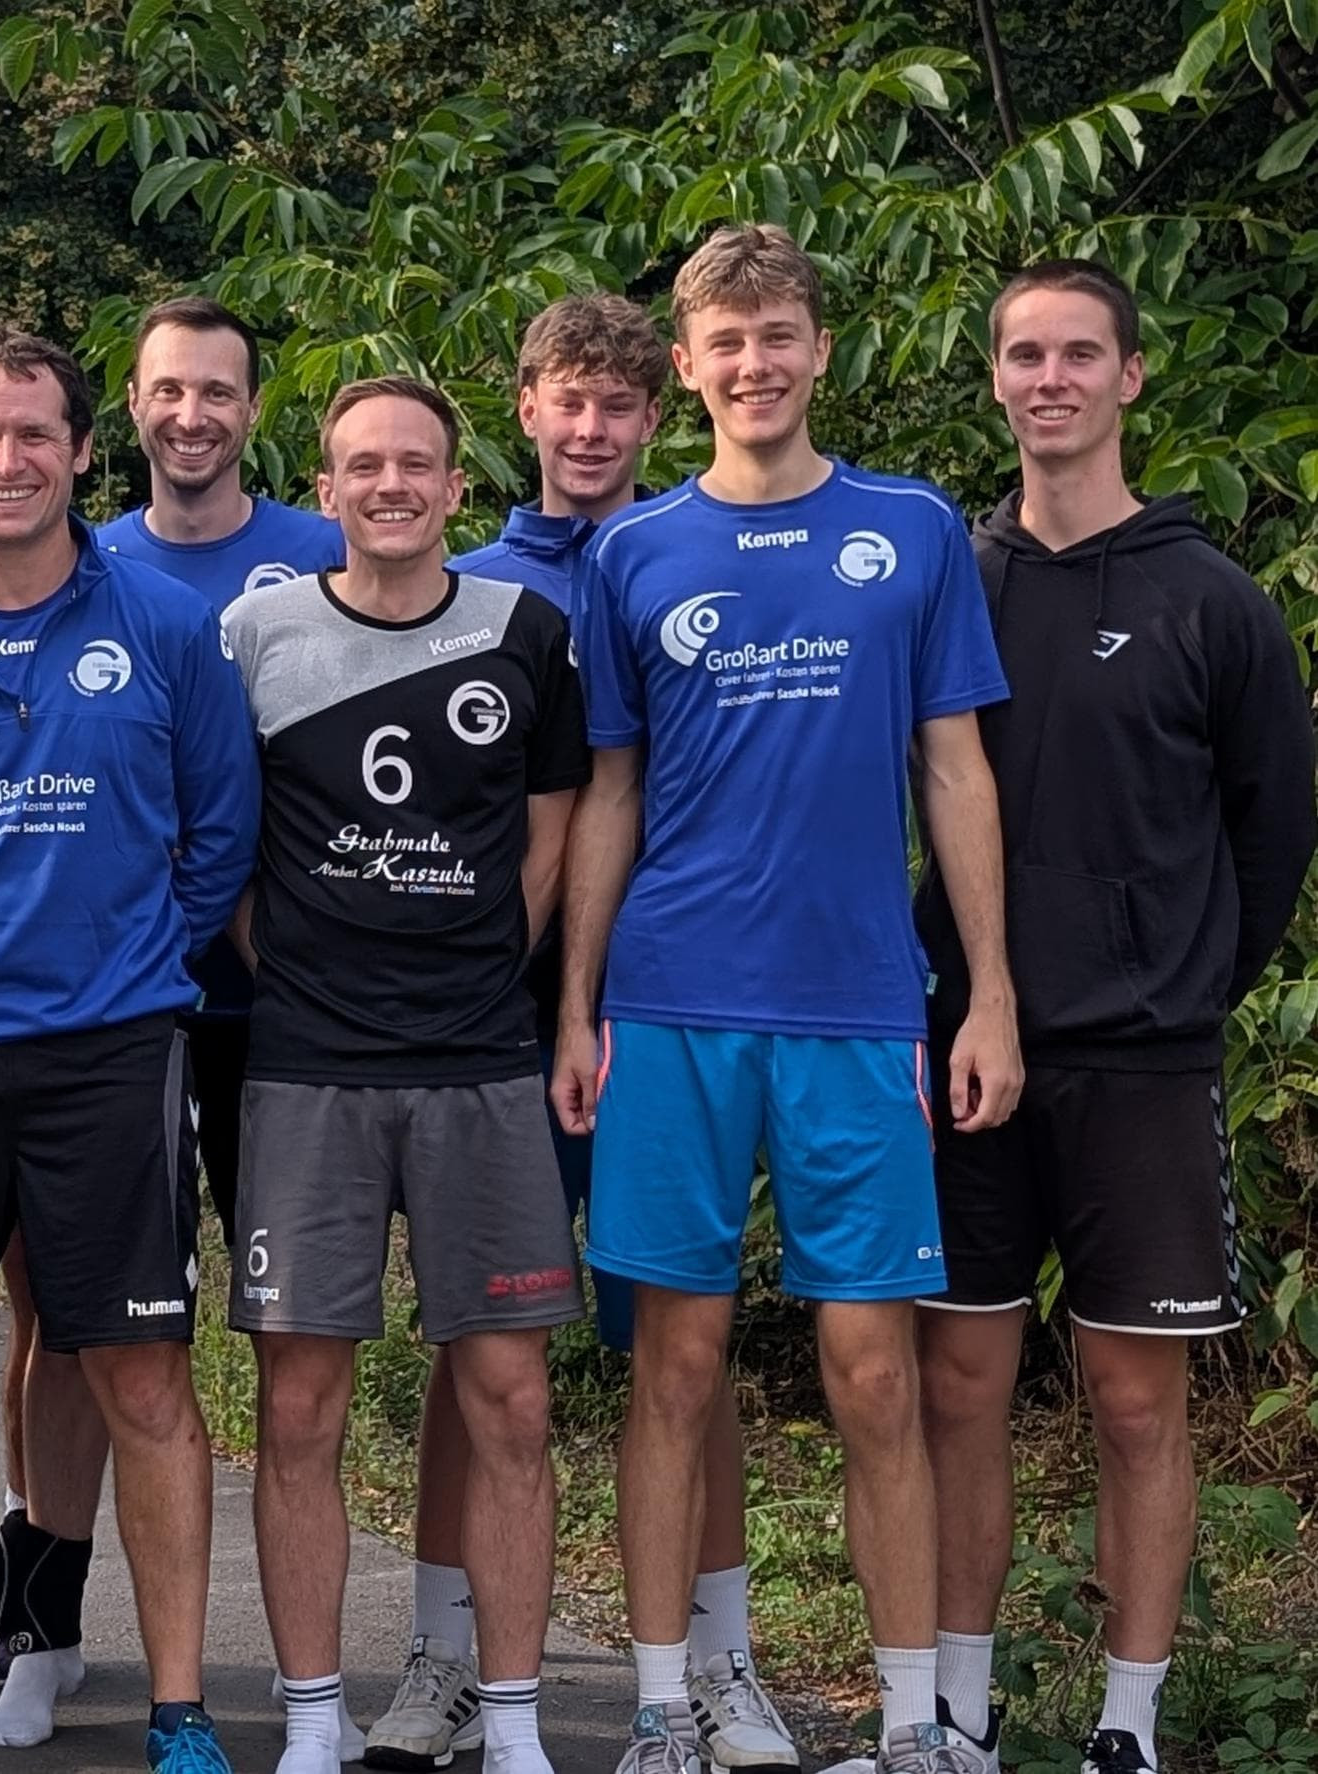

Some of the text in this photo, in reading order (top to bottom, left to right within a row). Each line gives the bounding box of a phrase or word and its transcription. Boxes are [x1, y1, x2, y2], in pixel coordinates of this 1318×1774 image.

[737, 529, 809, 551] Kempa
[429, 627, 493, 656] Kempa
[705, 635, 850, 672] Großart Drive
[362, 725, 413, 804] 6
[39, 773, 96, 795] Drive
[23, 822, 55, 833] Sascha
[327, 823, 451, 853] Grabmale
[361, 853, 476, 884] Kaszuba
[247, 1228, 269, 1278] 6
